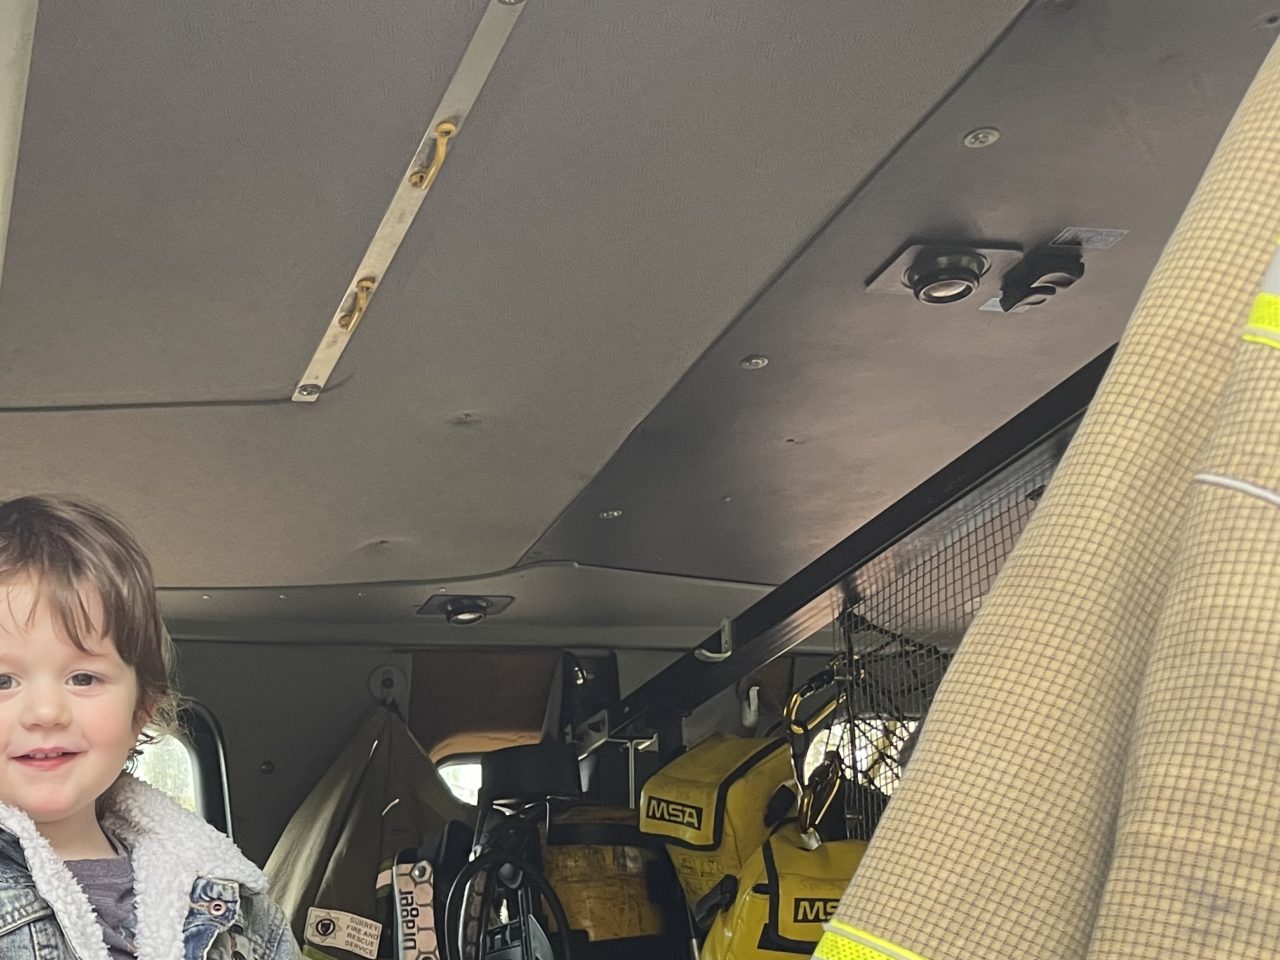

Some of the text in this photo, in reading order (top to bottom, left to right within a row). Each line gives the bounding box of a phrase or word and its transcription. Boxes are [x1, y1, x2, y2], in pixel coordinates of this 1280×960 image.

[648, 799, 699, 828] MSA
[797, 900, 841, 920] MS
[346, 924, 379, 941] FIRE AND
[349, 917, 379, 932] SURREY
[344, 939, 375, 957] SERVICE
[346, 932, 375, 948] RESCUE
